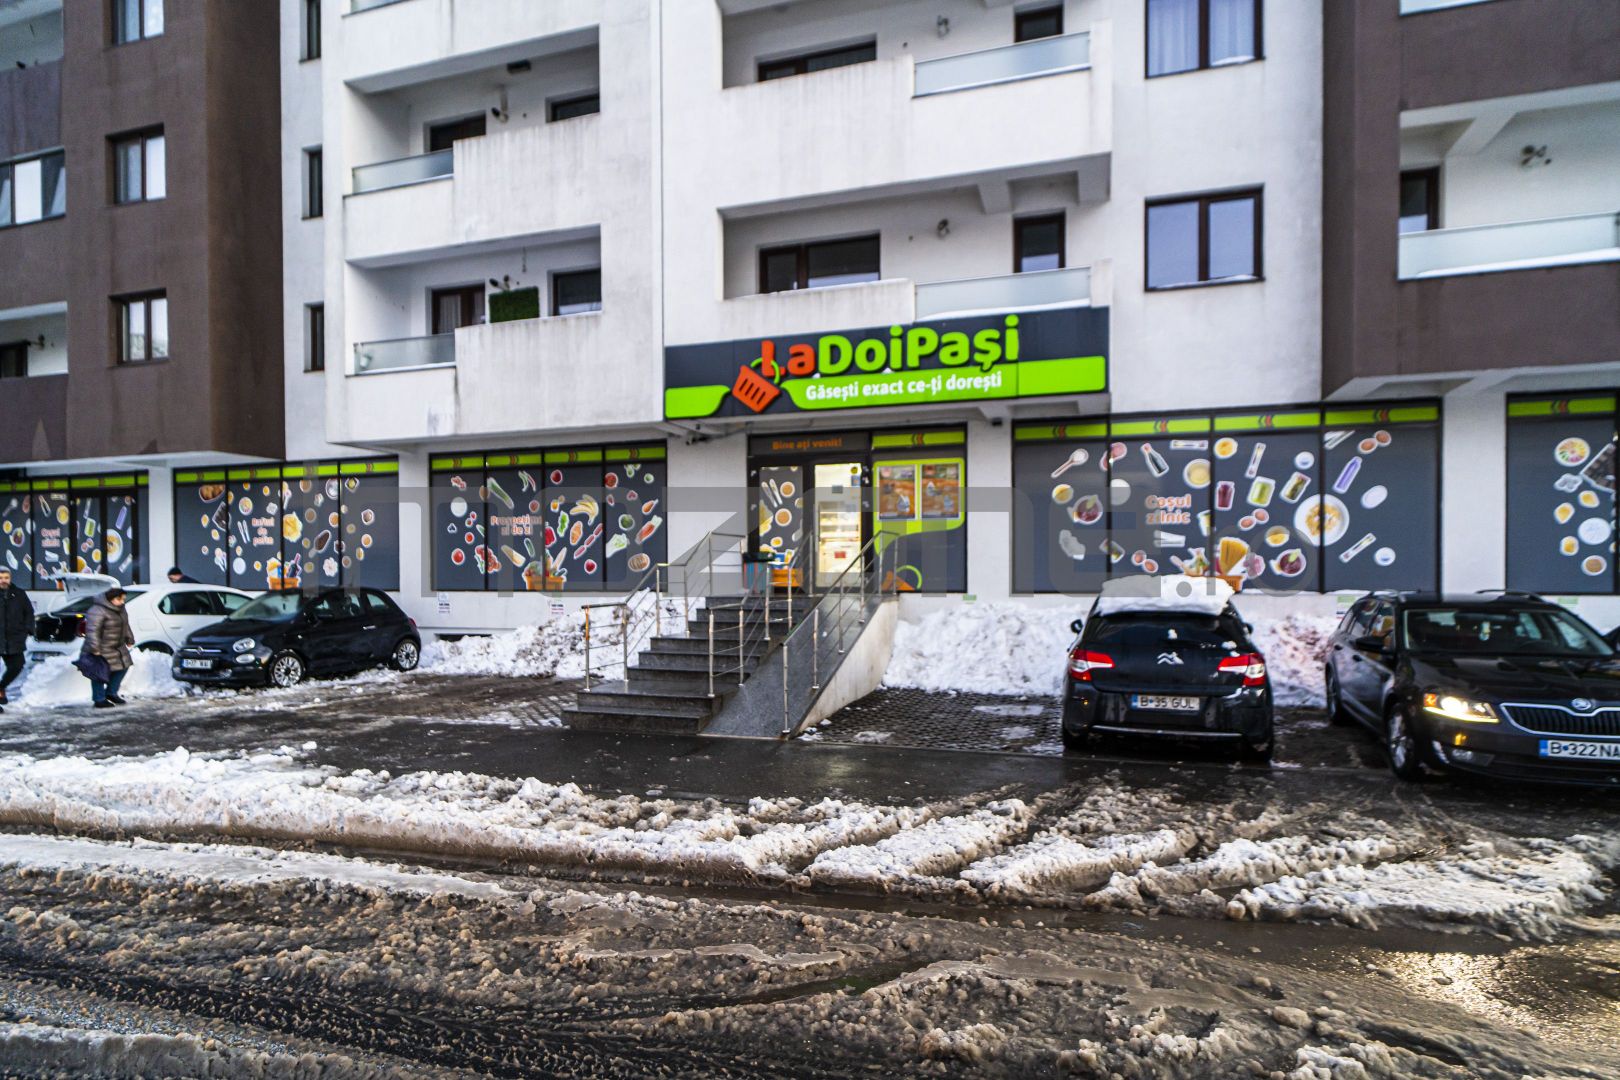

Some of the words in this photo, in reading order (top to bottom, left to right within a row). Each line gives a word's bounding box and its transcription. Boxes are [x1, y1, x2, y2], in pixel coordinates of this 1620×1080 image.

[805, 380, 859, 401] Găsești
[862, 378, 903, 396] exact
[907, 374, 942, 395] ce-ți
[945, 371, 1002, 391] dorești
[772, 440, 794, 450] Bine
[1145, 494, 1191, 512] Coșul
[1146, 509, 1191, 524] zilnic
